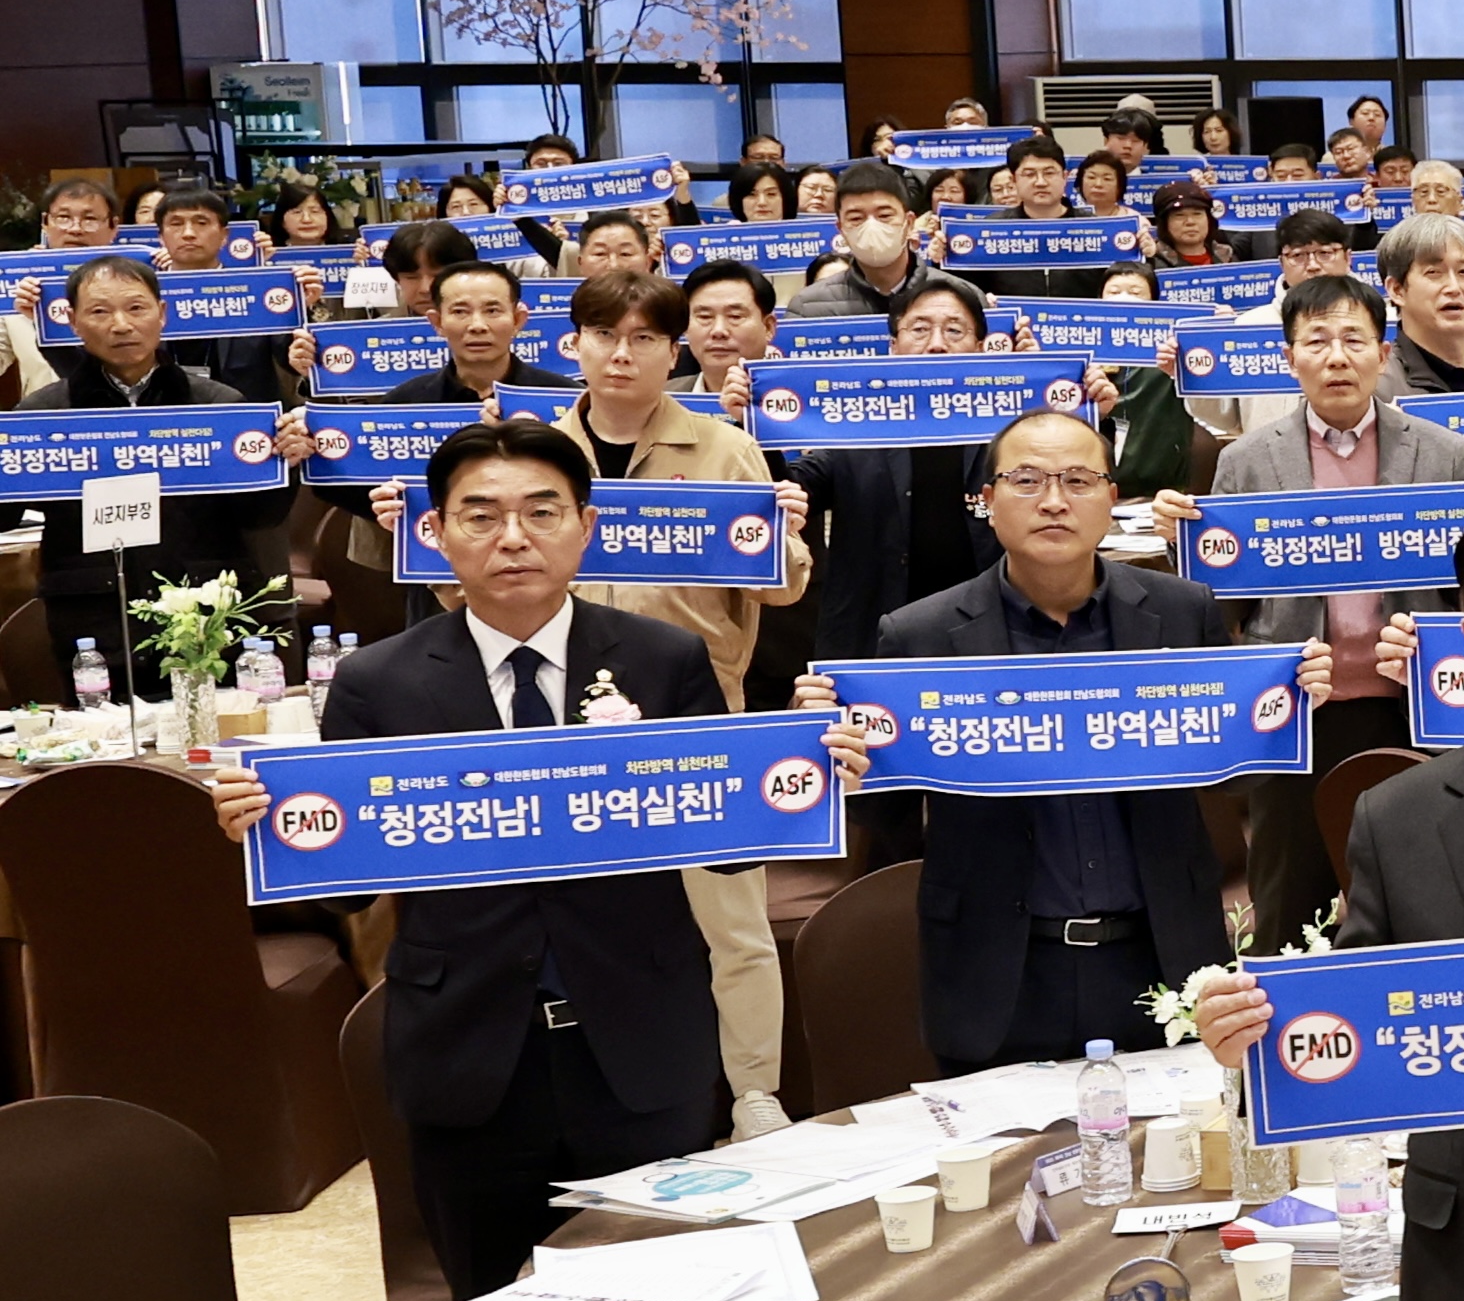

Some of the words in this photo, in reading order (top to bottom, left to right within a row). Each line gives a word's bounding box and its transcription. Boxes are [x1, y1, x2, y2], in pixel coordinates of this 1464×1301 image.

[531, 183, 588, 204] “청정전남!
[592, 176, 648, 197] 방역실천!”
[976, 234, 1041, 256] “청정전남!
[1046, 233, 1110, 254] 방역실천!”
[809, 390, 916, 424] “청정전남!
[929, 388, 1037, 421] 방역실천!”
[113, 441, 222, 474] 방역실천!”
[91, 498, 154, 529] 시군지부장
[1247, 529, 1363, 567] “청정전남!
[1259, 696, 1284, 718] ASF
[910, 713, 1064, 757] “청정전남!
[1086, 702, 1237, 750] 방역실천!”
[771, 772, 813, 797] ASF
[282, 809, 337, 834] FMD
[358, 792, 542, 847] “청정전남!
[568, 777, 743, 833] 방역실천!”
[1289, 1032, 1352, 1063] FMD
